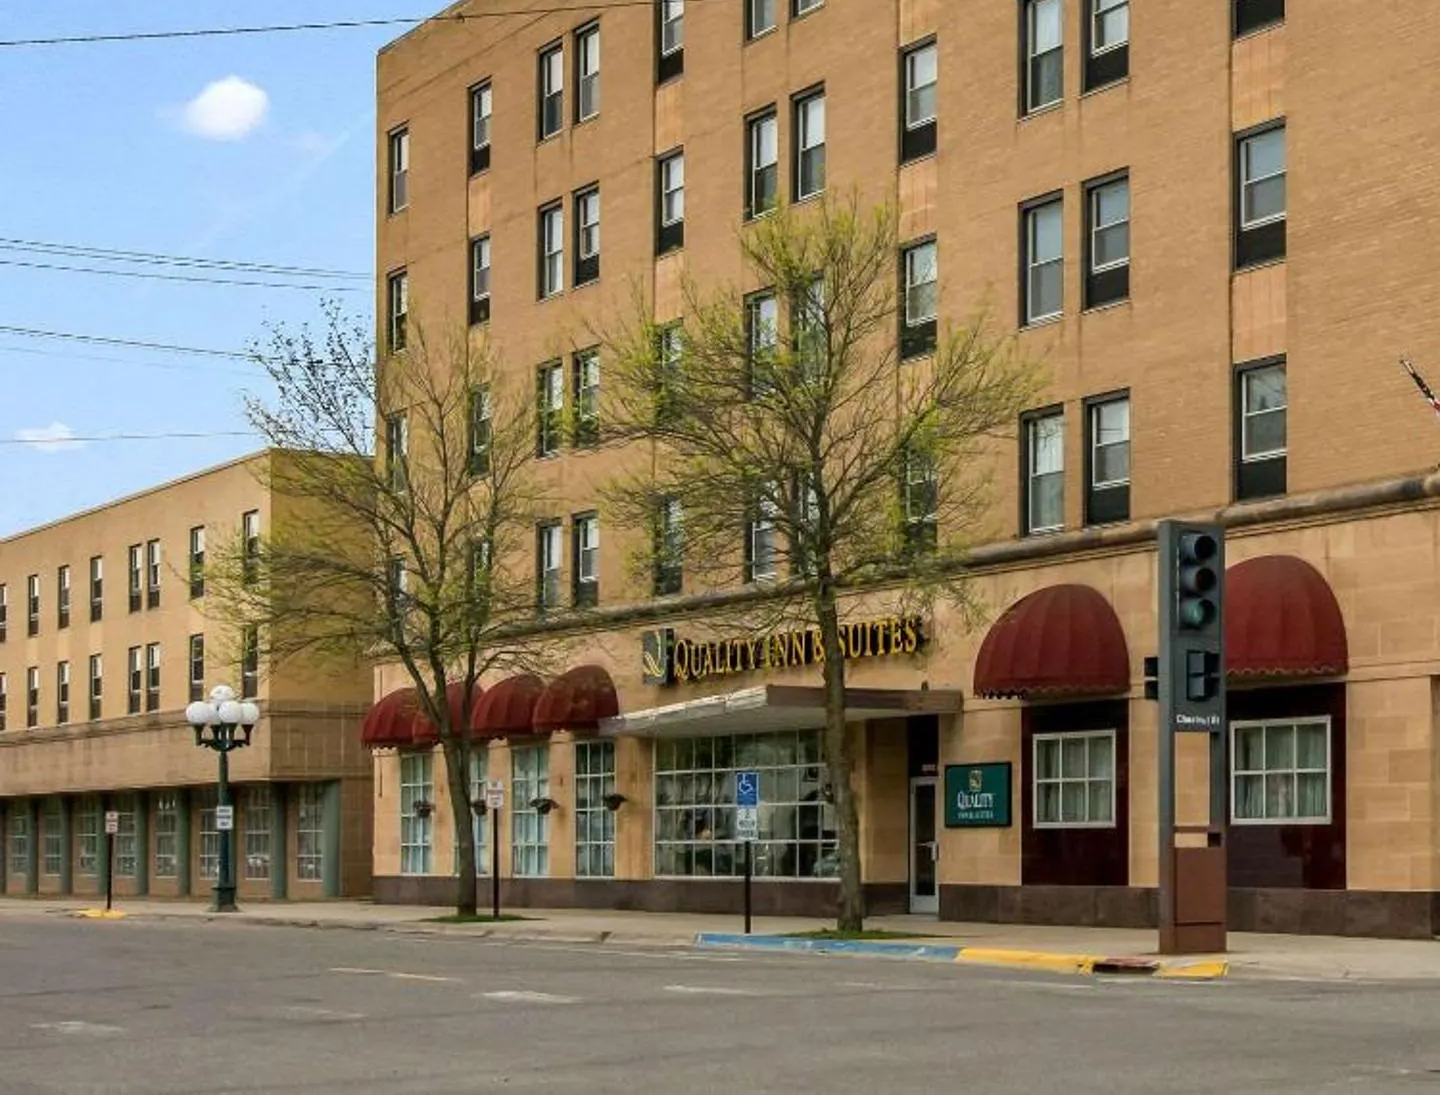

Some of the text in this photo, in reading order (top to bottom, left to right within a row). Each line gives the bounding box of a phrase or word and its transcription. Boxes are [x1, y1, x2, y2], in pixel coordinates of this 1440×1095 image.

[674, 638, 757, 680] QUALITY
[762, 631, 806, 668] INN
[957, 790, 994, 809] QUALITY
